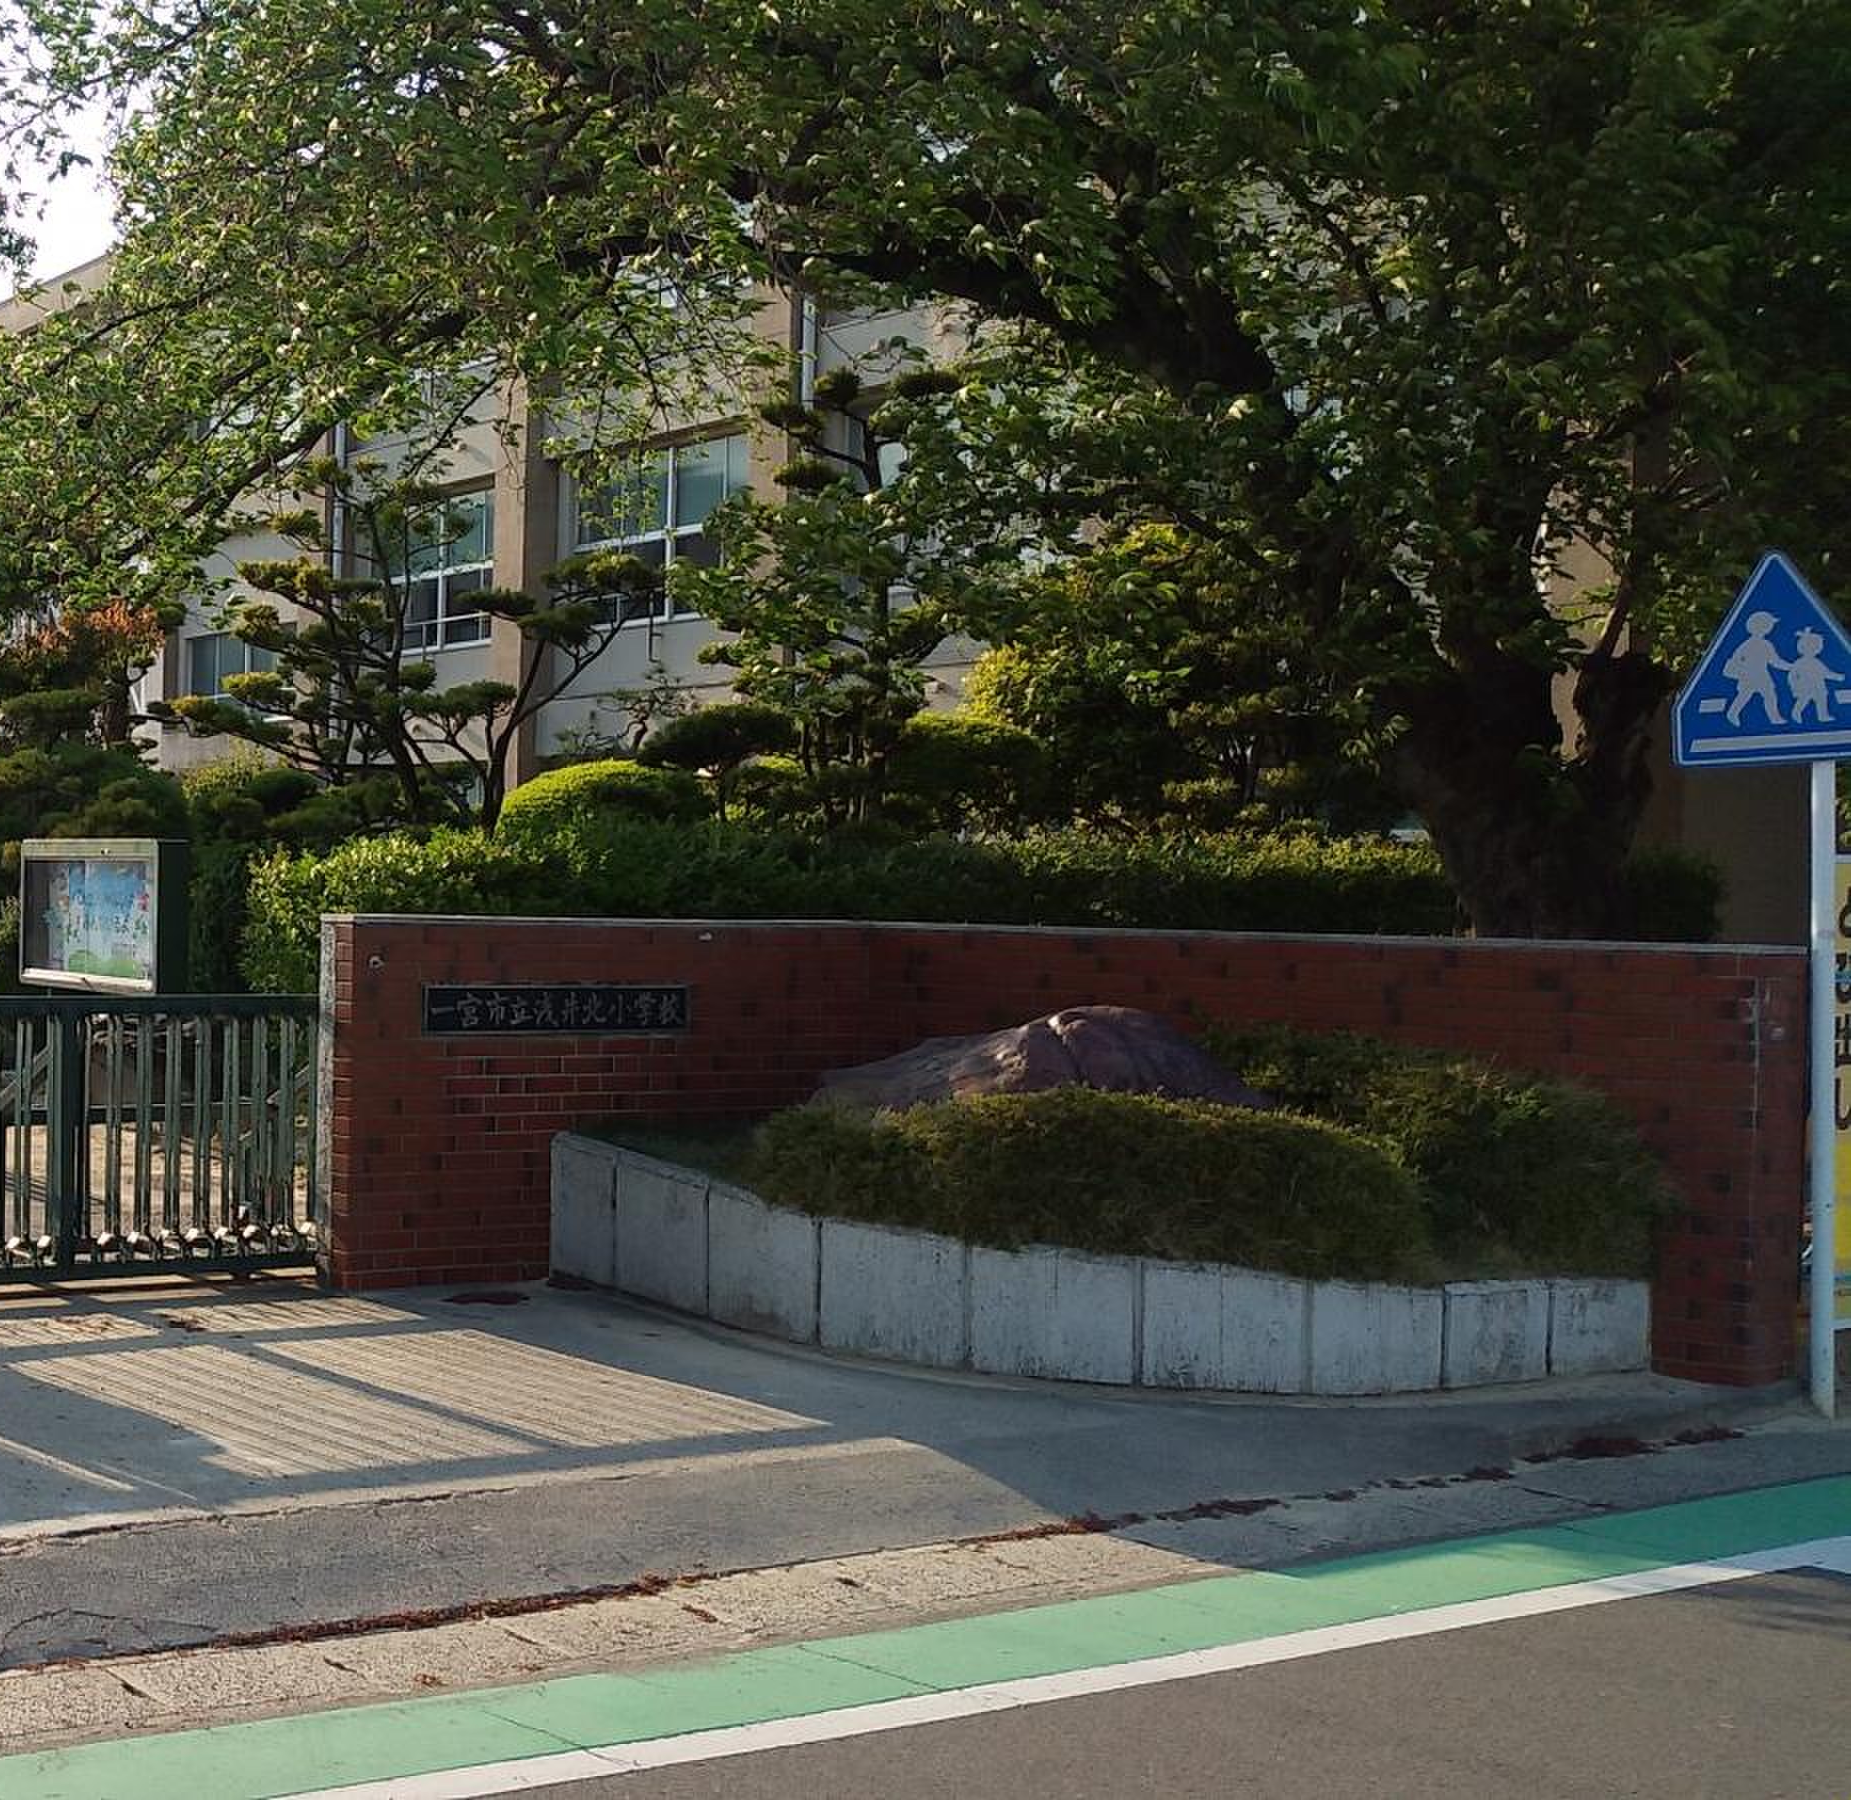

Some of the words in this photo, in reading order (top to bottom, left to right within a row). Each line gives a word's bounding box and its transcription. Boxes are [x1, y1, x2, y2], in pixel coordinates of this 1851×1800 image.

[430, 991, 684, 1027] 一宮市立浅井北小学校
